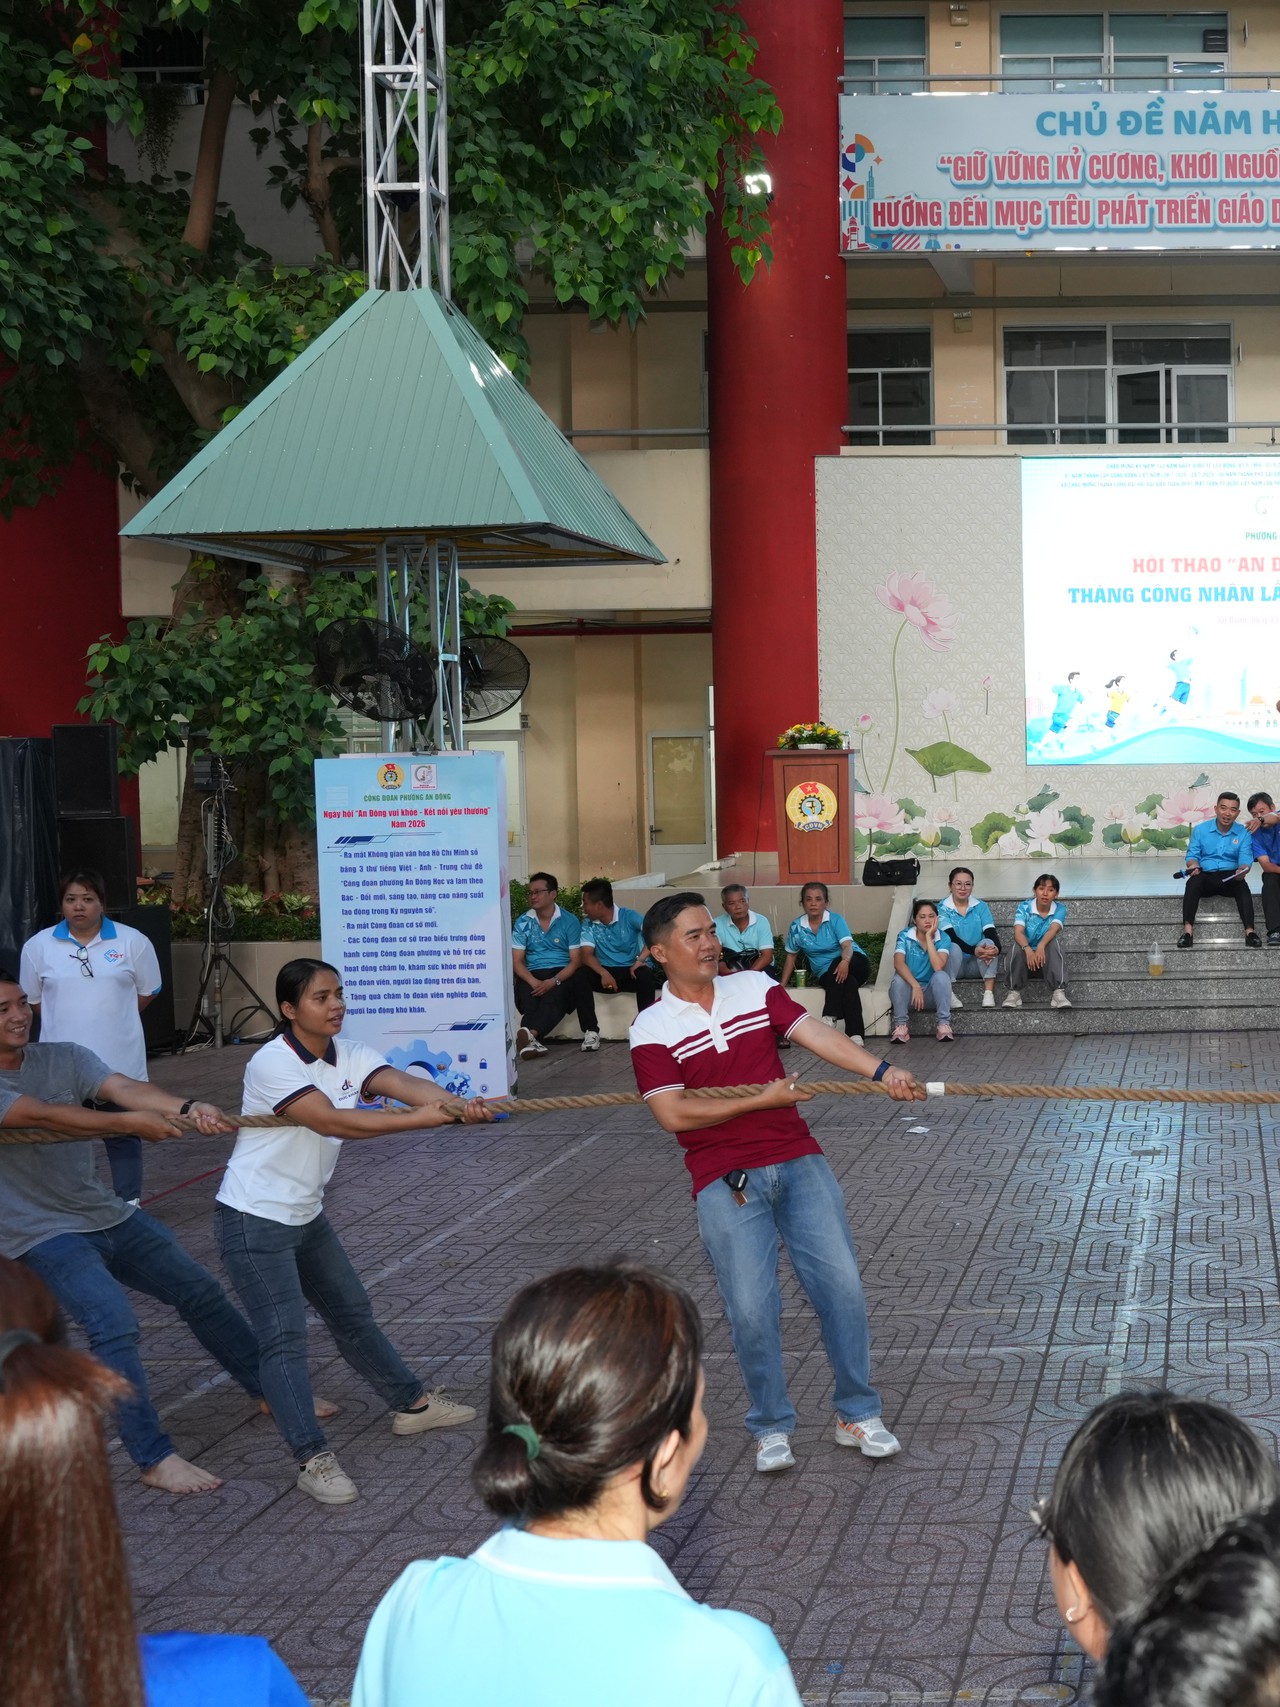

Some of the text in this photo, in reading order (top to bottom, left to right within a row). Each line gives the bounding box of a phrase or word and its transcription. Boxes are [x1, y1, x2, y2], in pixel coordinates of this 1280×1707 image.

[1036, 101, 1107, 136] CHỦ
[1117, 96, 1165, 136] ĐỀ
[1174, 101, 1251, 135] NĂM
[994, 148, 1049, 181] VỮNG
[1056, 146, 1081, 181] KỶ
[1089, 152, 1164, 183] CƯƠNG,
[1171, 152, 1217, 180] KHƠI
[873, 193, 942, 227] HƯỚNG
[948, 194, 988, 226] ĐẾN
[995, 200, 1041, 231] MỤC
[1049, 193, 1090, 226] TIÊU
[1098, 193, 1148, 225] PHÁT
[1155, 192, 1210, 225] TRIỂN
[1218, 191, 1262, 224] GIÁO
[1171, 557, 1221, 572] THAO
[1068, 583, 1133, 604] THÁNG
[1141, 584, 1191, 603] CÔNG
[1198, 582, 1255, 603] NHÂN
[389, 808, 399, 816] vui
[408, 820, 425, 828] 2026
